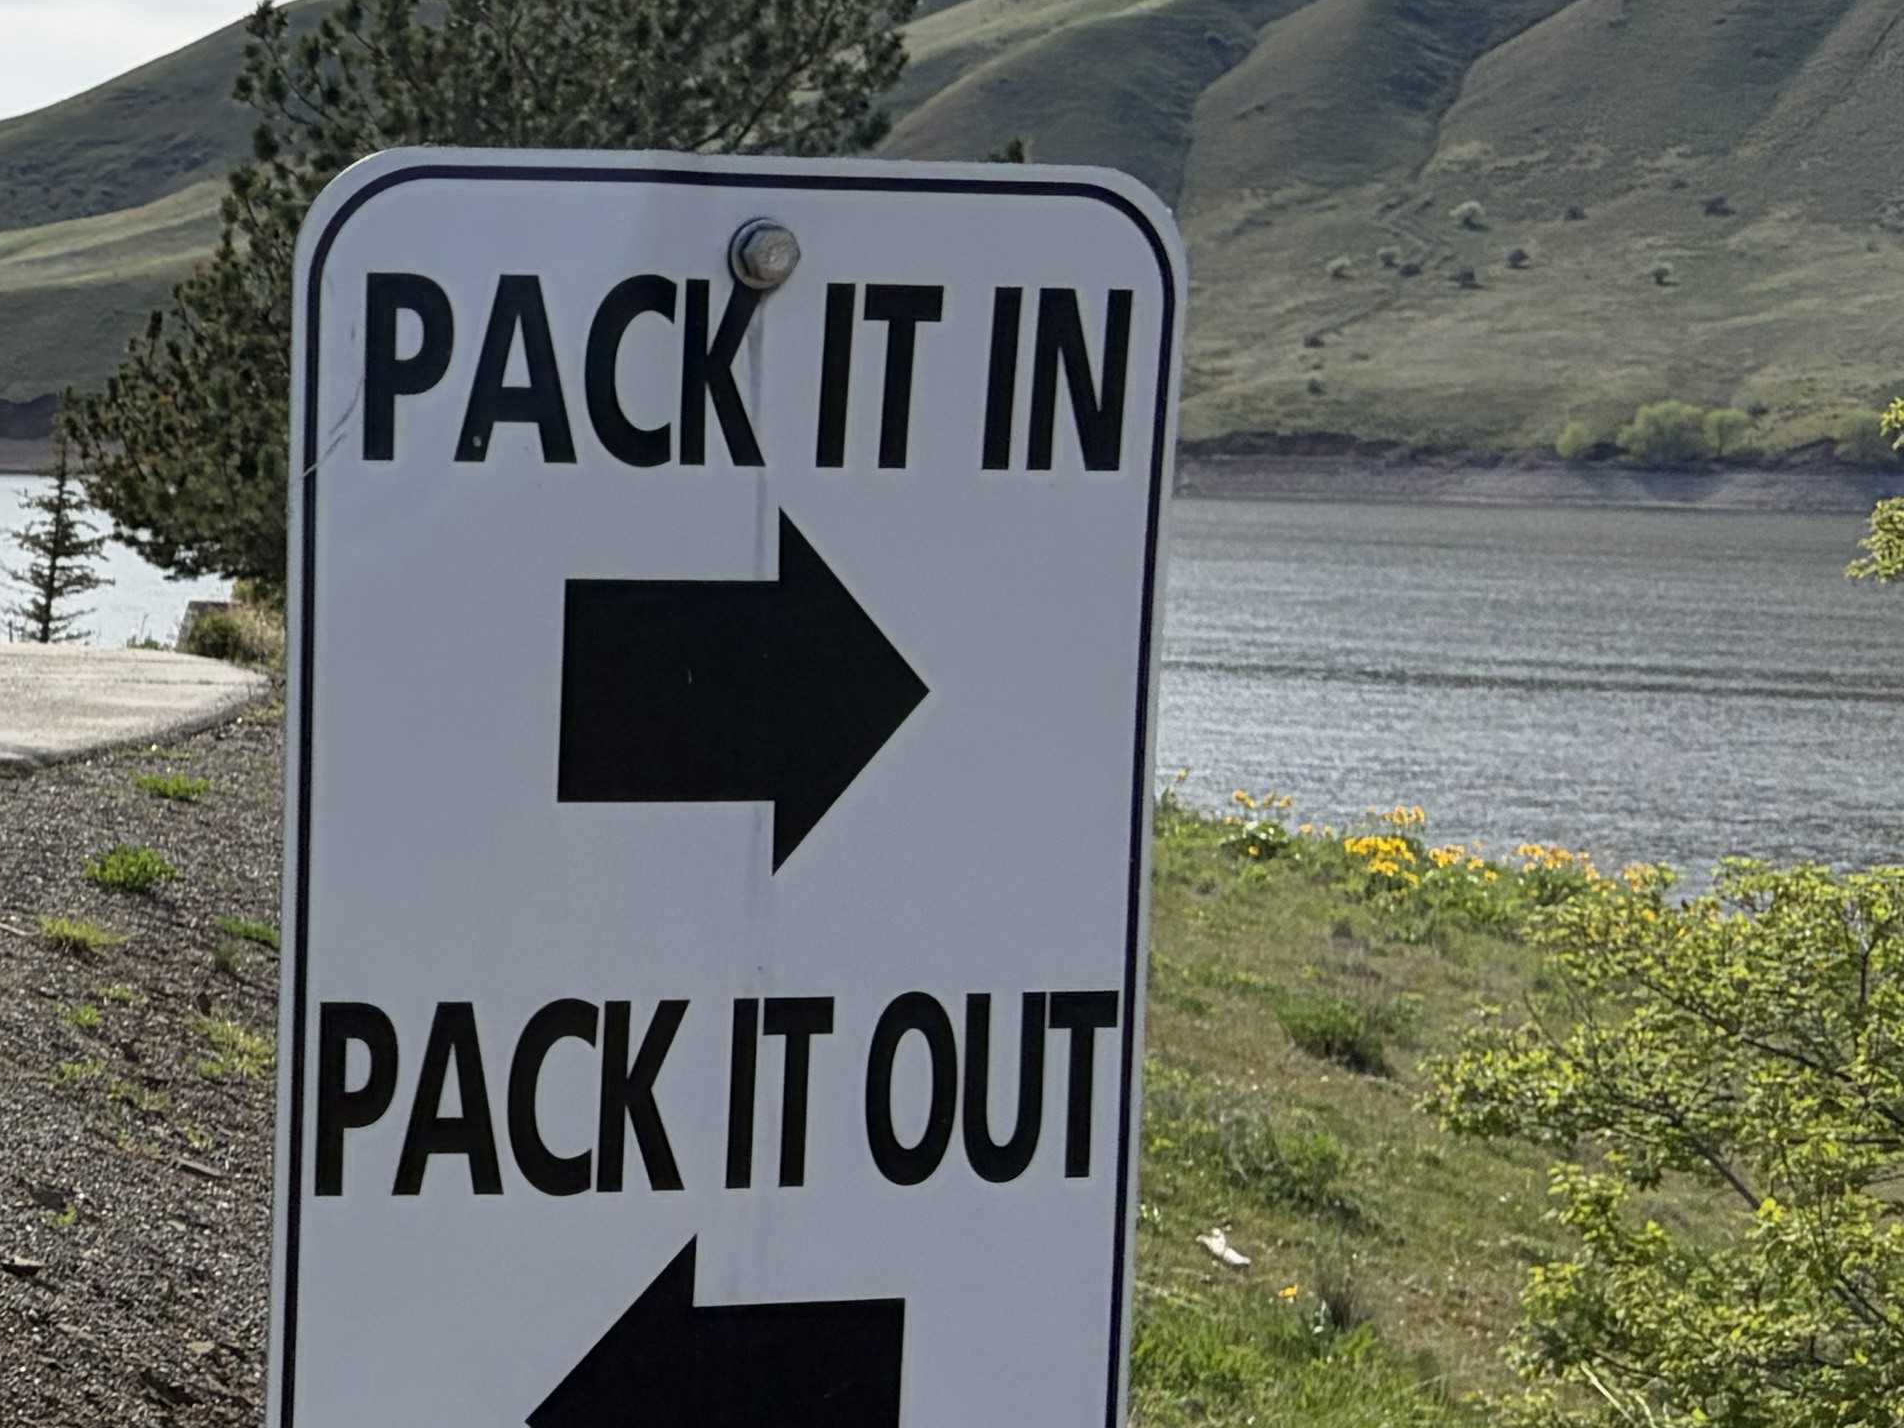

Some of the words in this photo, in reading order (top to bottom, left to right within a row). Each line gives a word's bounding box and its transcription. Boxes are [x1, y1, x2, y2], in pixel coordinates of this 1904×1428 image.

[363, 272, 766, 468] PACK
[816, 283, 944, 469] IT
[982, 286, 1133, 471] IN
[315, 998, 690, 1196] PACK
[726, 996, 834, 1189] IT
[865, 990, 1119, 1186] OUT
